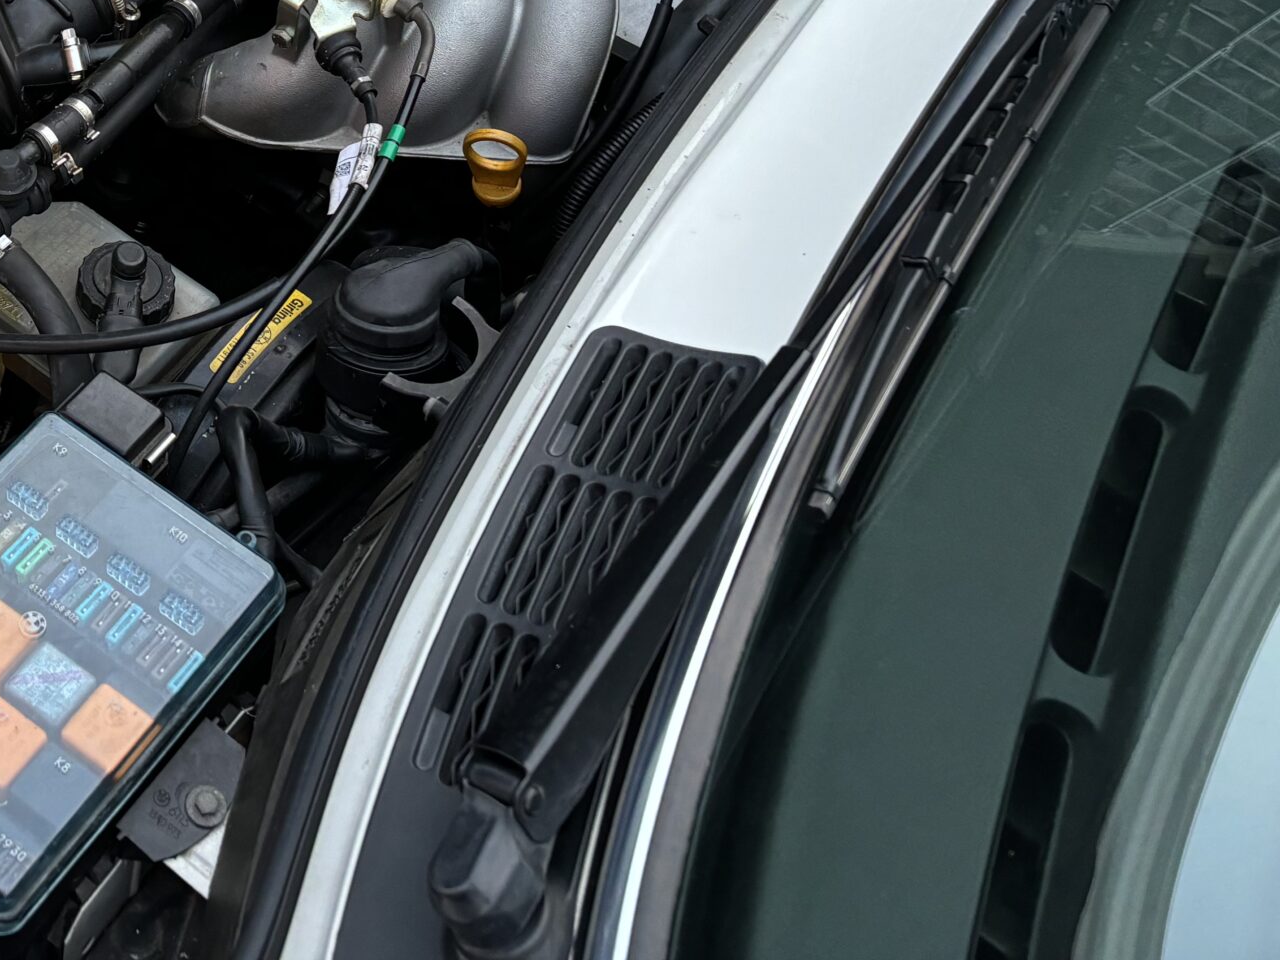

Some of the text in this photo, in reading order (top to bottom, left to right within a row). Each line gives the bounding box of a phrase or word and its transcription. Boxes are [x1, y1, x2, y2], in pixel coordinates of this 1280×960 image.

[272, 297, 303, 324] Girling
[51, 441, 68, 457] K9
[168, 526, 188, 544] K10
[53, 756, 72, 773] K8
[9, 844, 27, 861] 30
